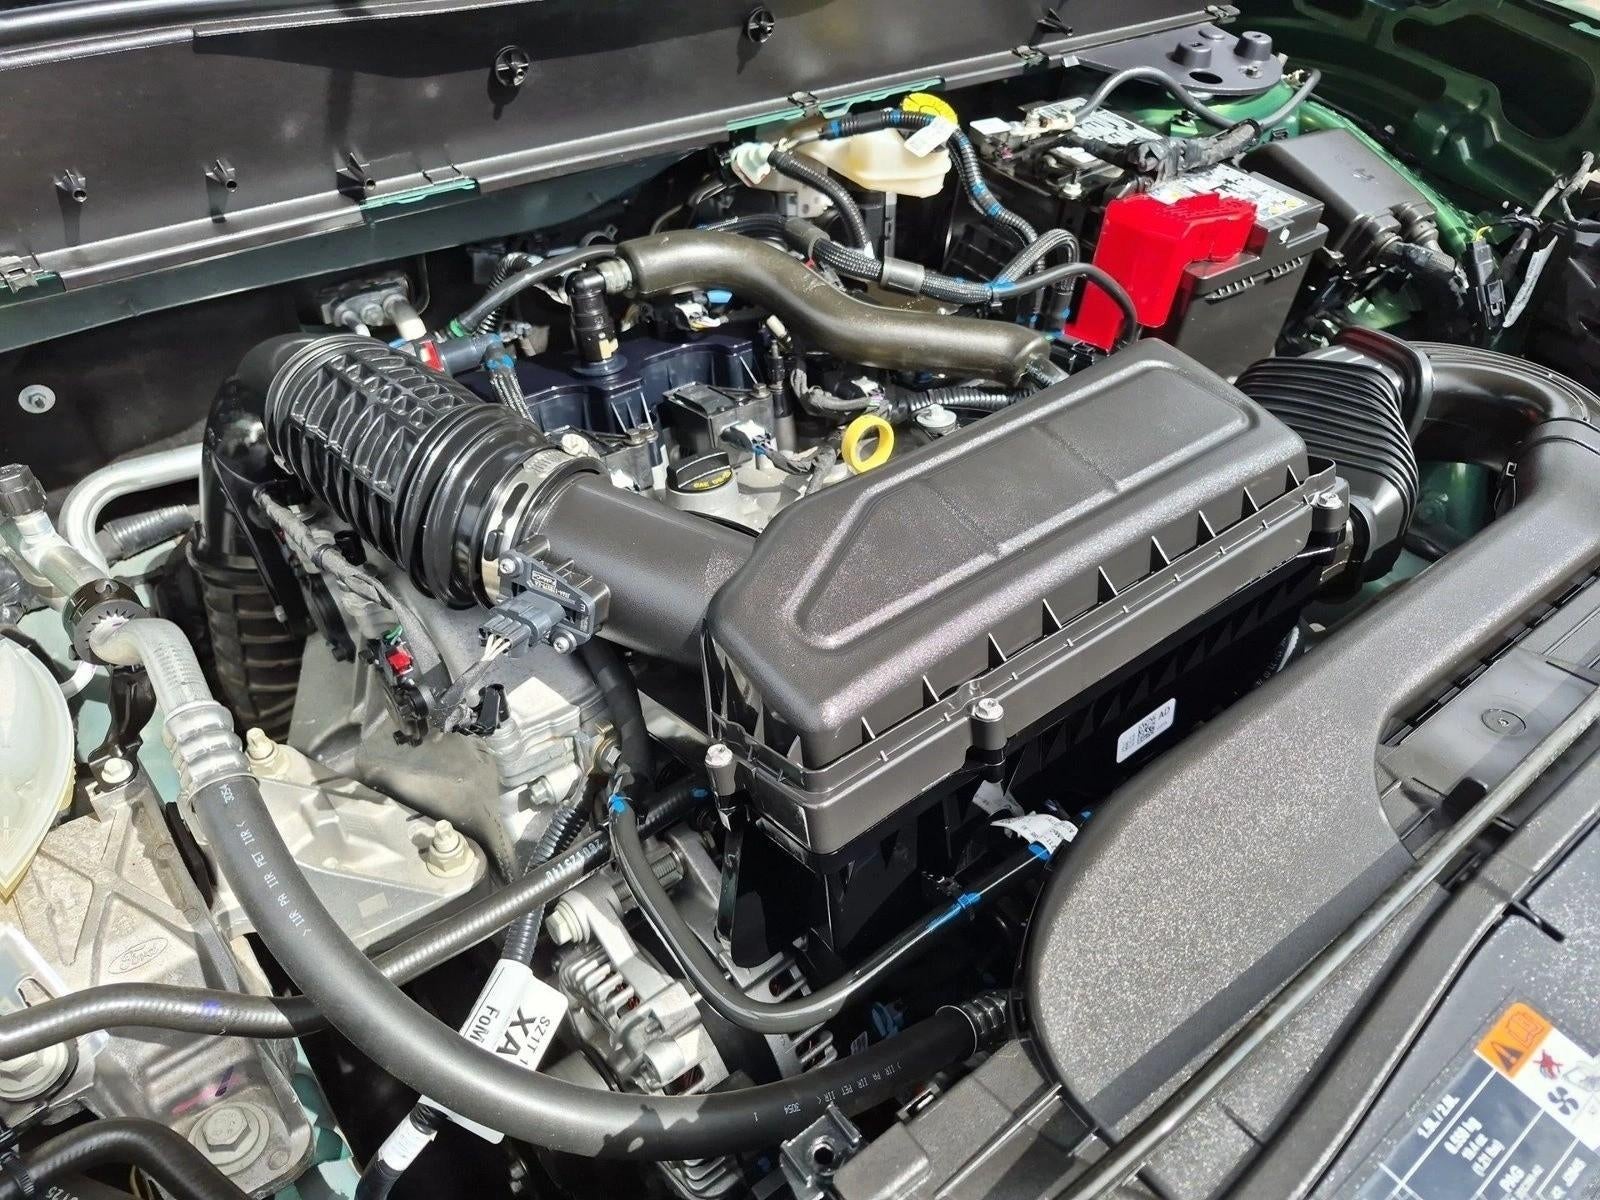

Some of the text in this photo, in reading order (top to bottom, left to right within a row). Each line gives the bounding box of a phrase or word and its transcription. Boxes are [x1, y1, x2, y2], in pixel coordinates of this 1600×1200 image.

[219, 784, 235, 804] 3054
[251, 851, 268, 868] PET
[264, 871, 279, 889] IIR
[278, 893, 290, 908] PA
[496, 1007, 537, 1056] XA
[857, 1076, 869, 1089] IIR
[872, 1072, 882, 1081] PA
[841, 1084, 854, 1096] PET
[783, 1102, 801, 1115] 3054
